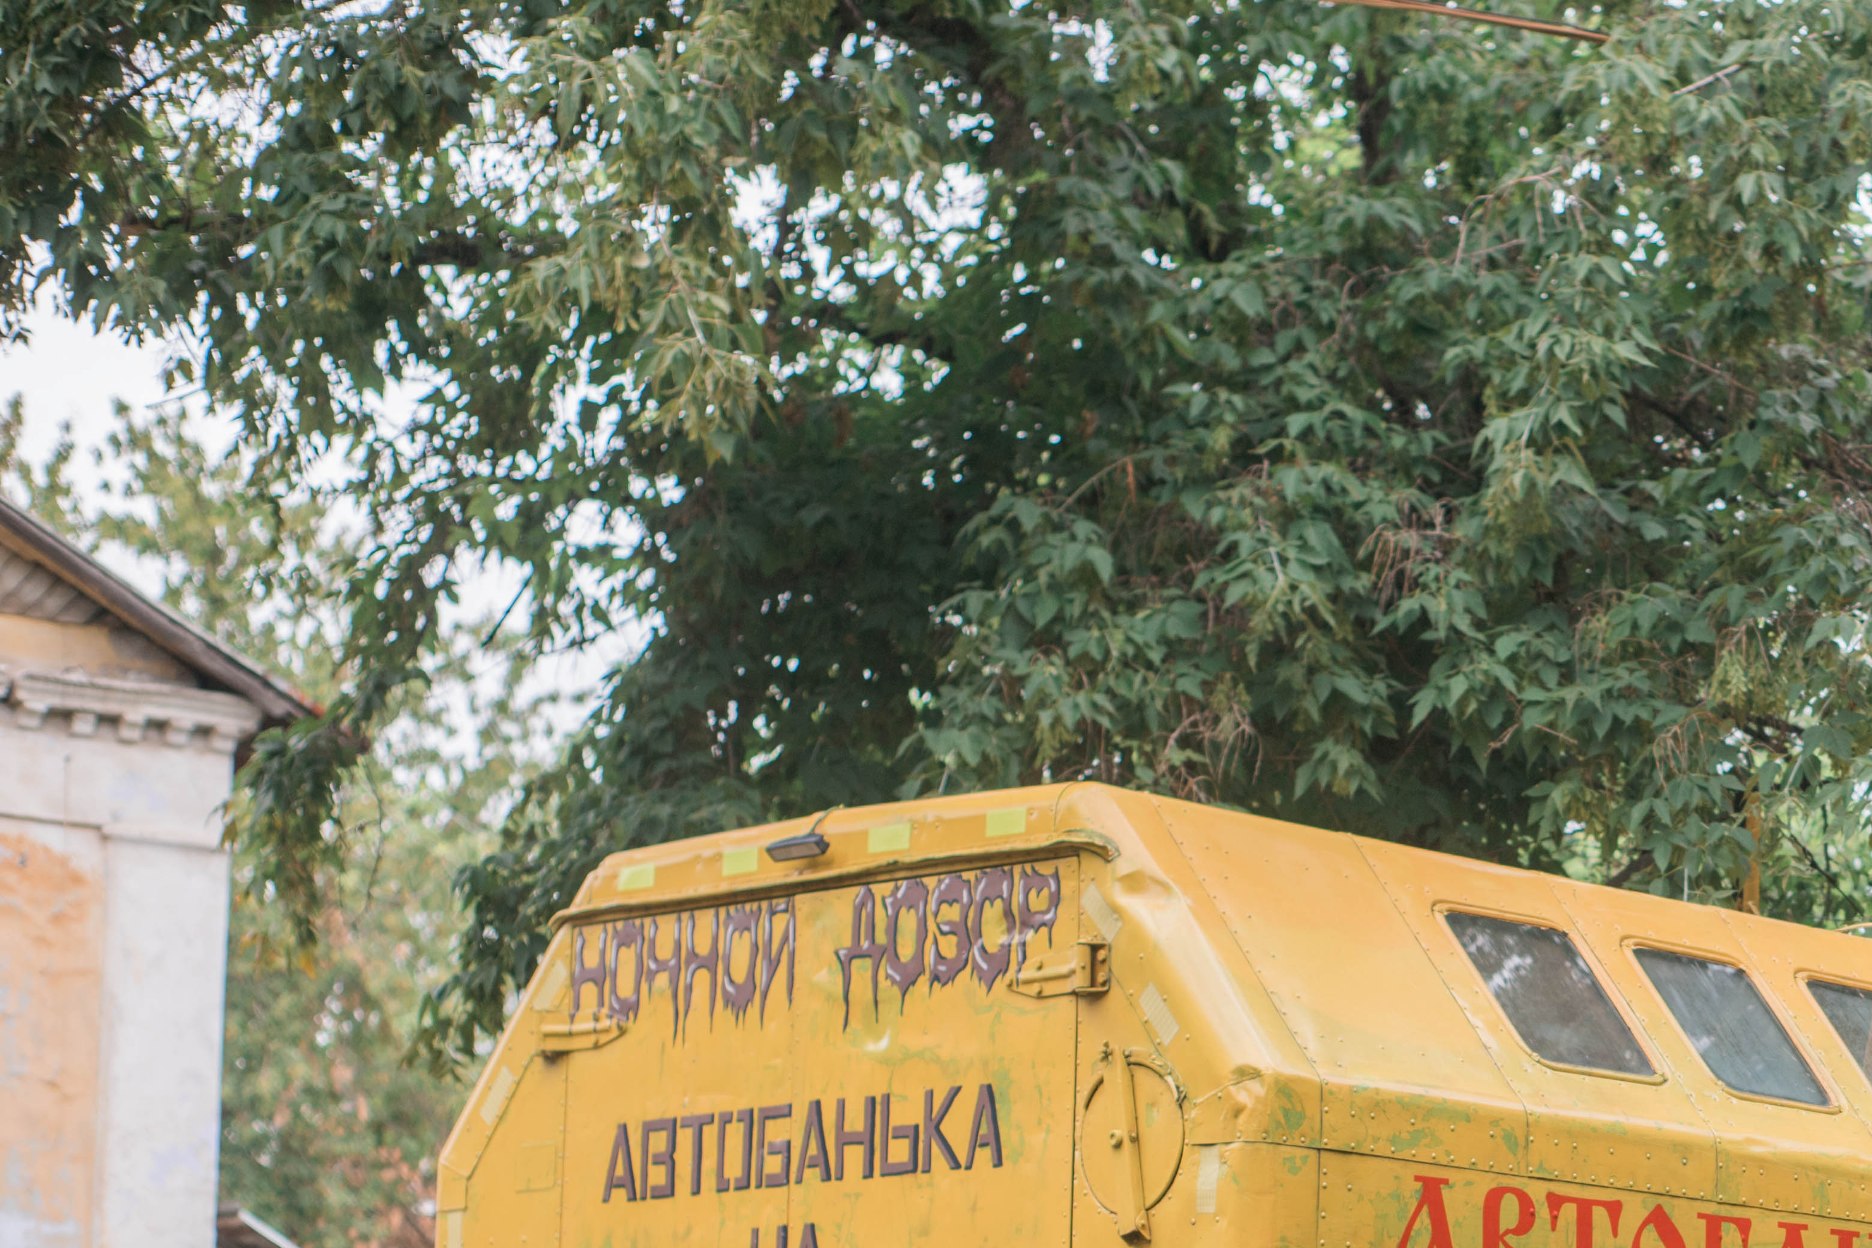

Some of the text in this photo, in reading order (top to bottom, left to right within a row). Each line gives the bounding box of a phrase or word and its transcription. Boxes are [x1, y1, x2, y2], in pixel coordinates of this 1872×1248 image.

[571, 863, 1061, 1047] НОЧНОЙ ДОЗОР
[601, 1082, 1004, 1204] АВТОБАНЬКА
